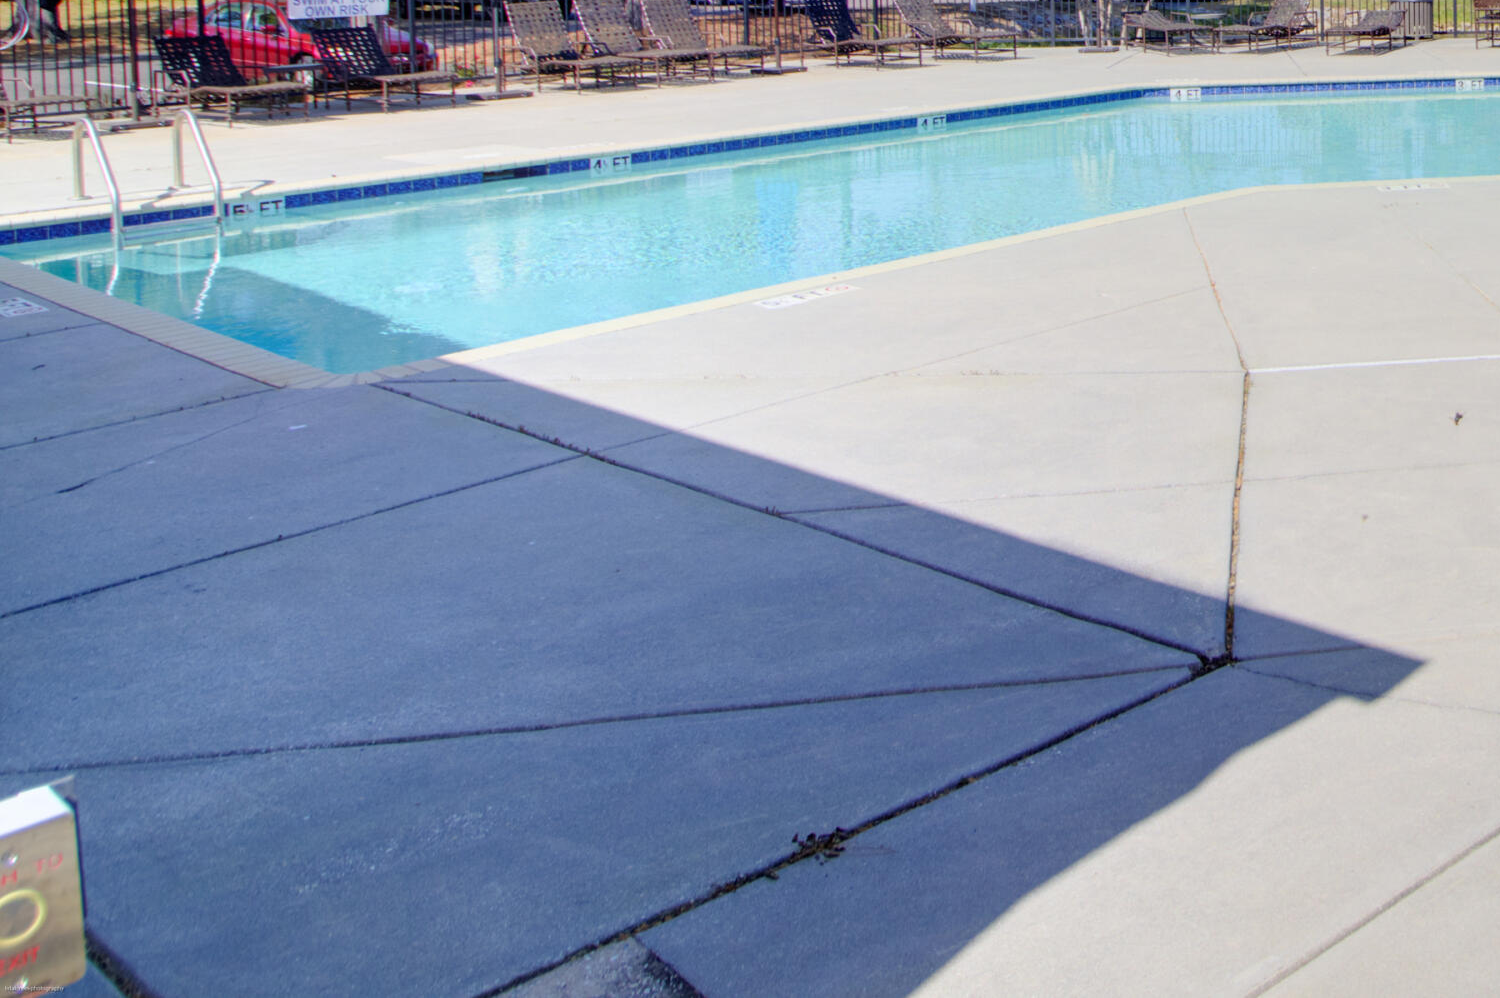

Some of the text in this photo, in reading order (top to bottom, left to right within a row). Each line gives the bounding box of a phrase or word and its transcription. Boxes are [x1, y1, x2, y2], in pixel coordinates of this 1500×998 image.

[305, 4, 369, 17] OWN RISK
[259, 199, 283, 212] FT
[36, 851, 64, 875] TO
